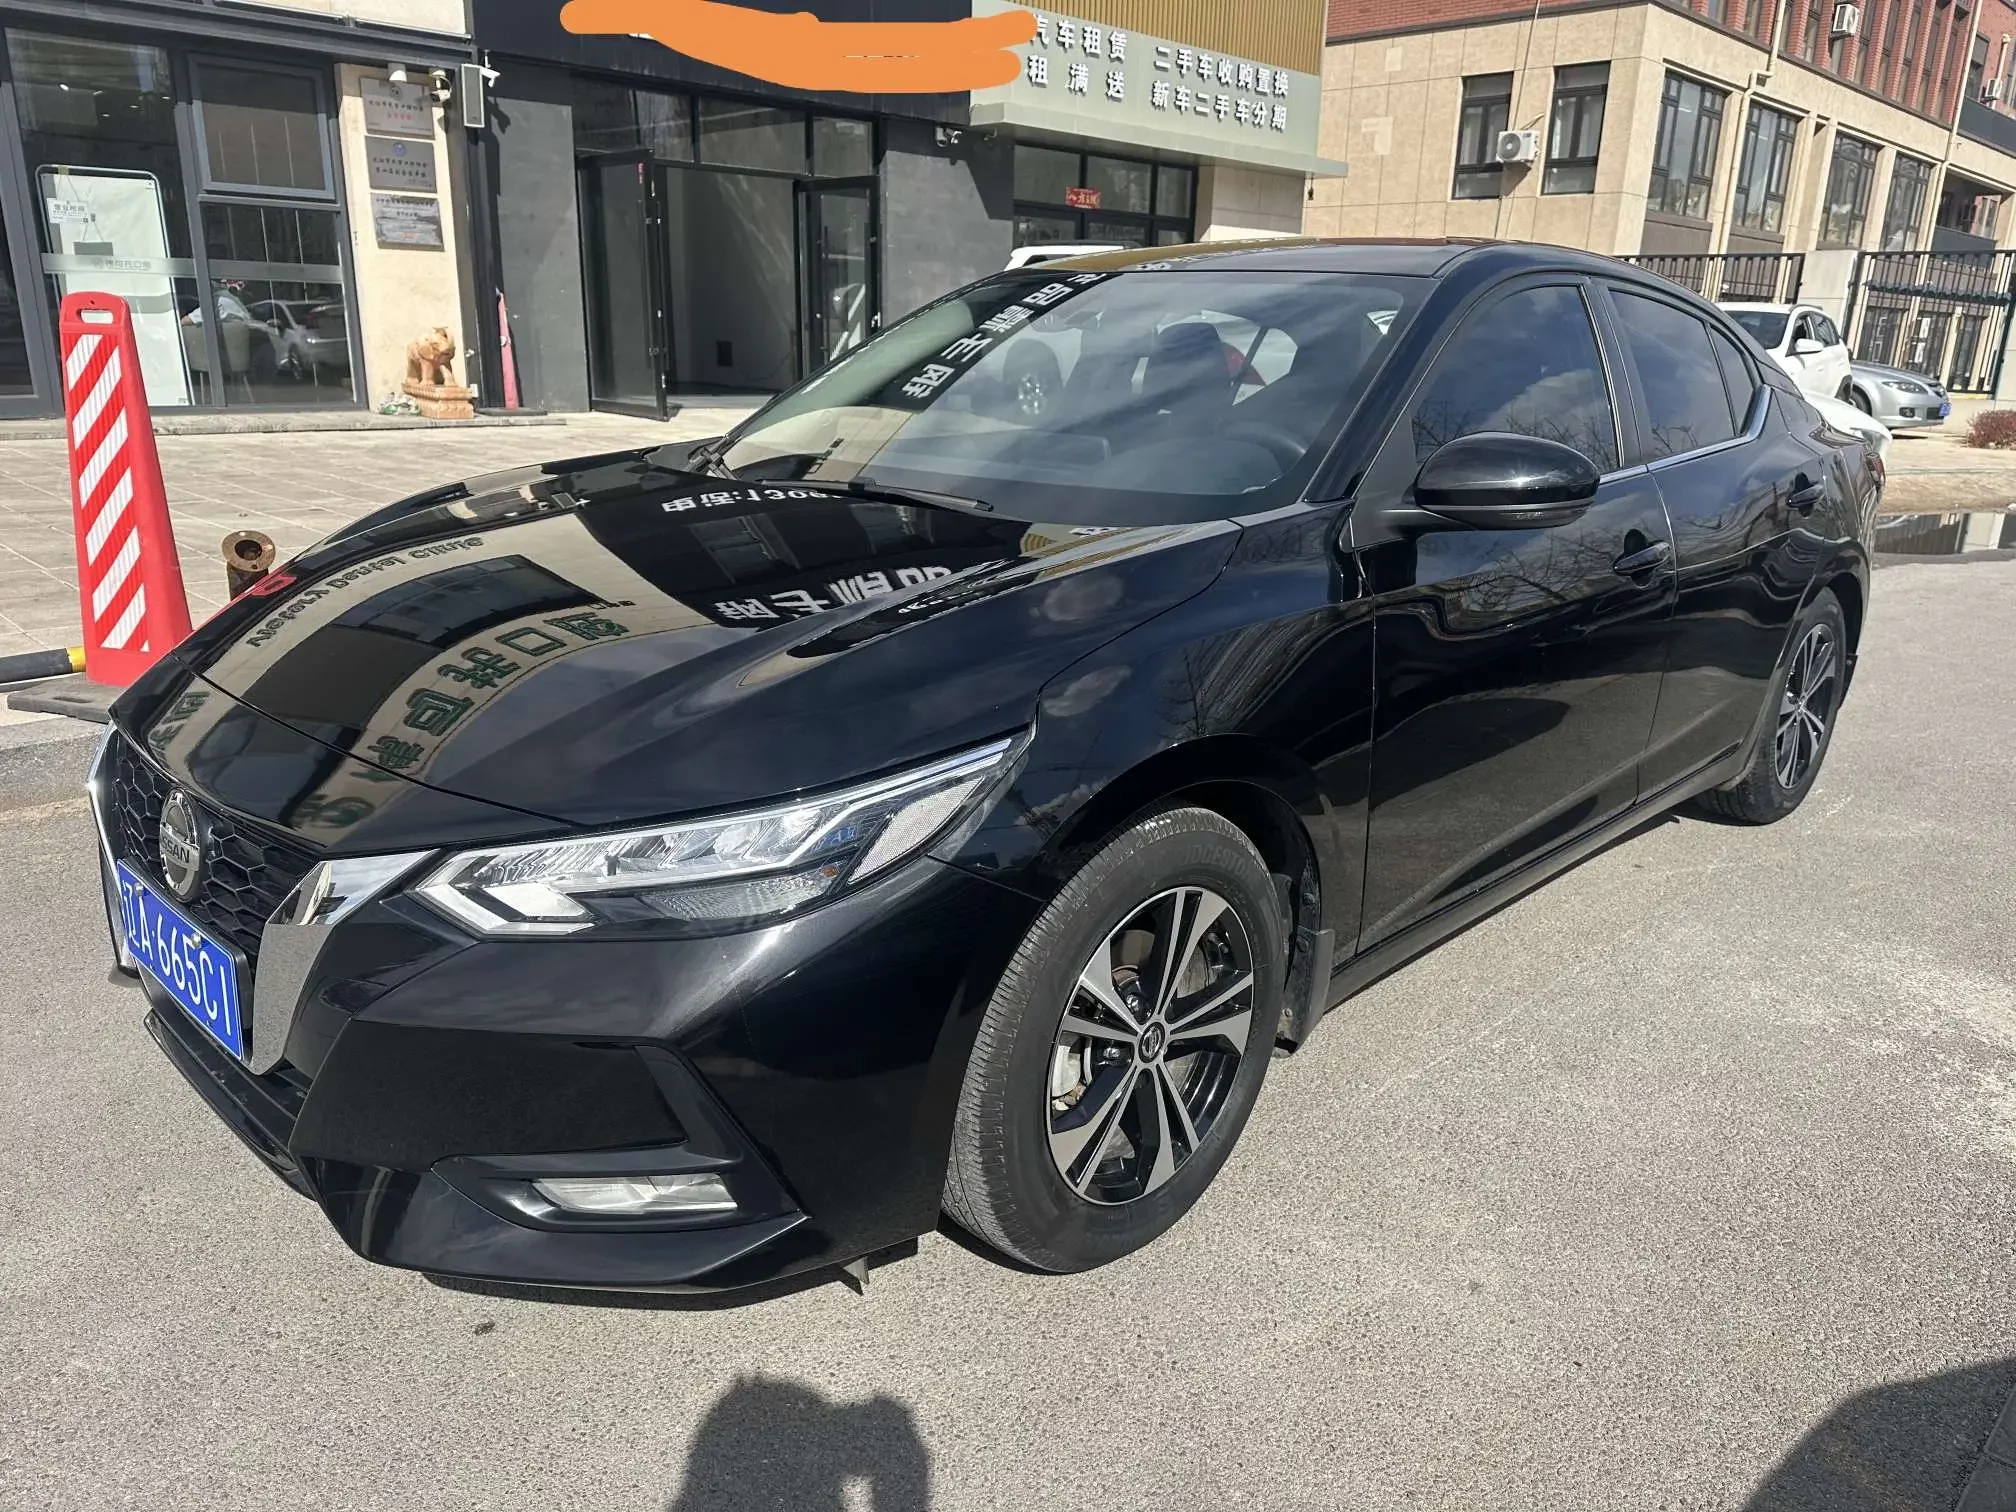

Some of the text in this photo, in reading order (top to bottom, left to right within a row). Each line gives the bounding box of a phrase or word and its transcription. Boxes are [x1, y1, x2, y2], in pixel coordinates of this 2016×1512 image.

[1154, 46, 1290, 98] 二手车收购置换
[1151, 80, 1288, 130] 新车二手车分期
